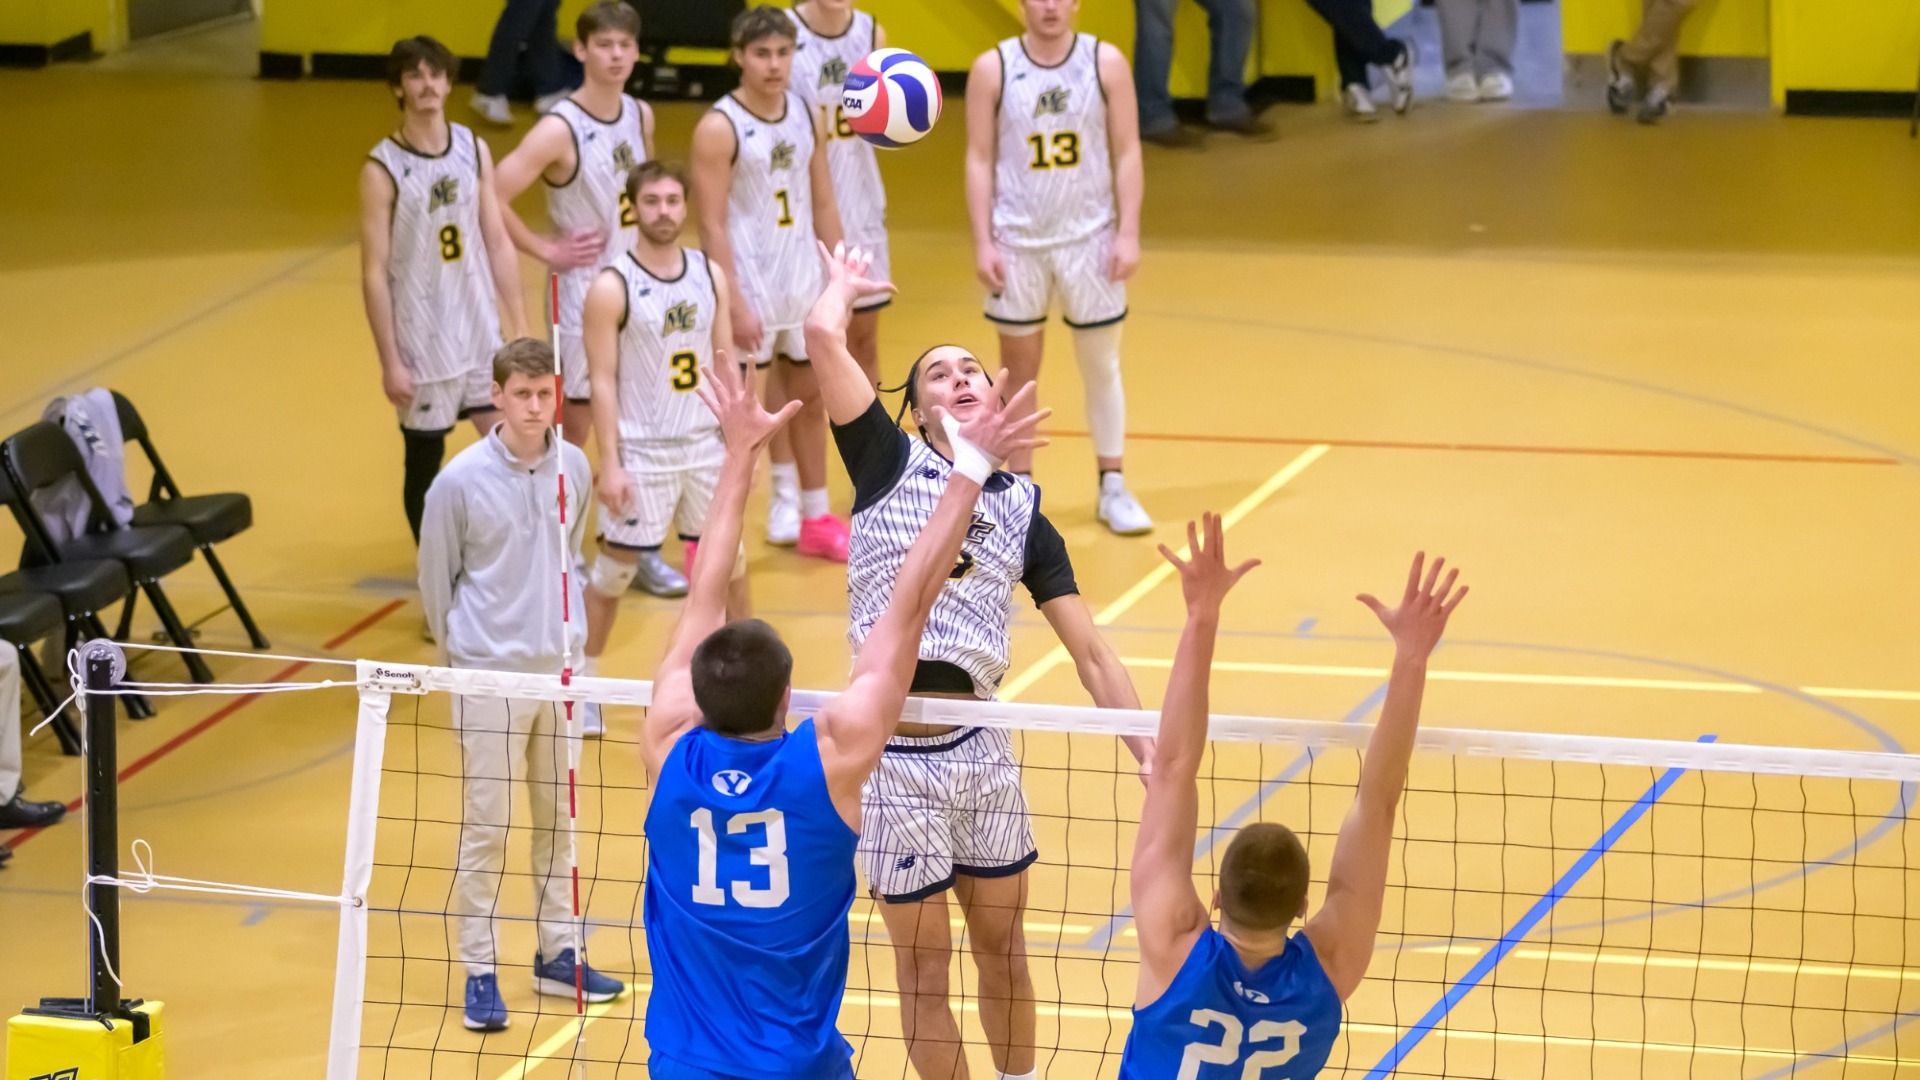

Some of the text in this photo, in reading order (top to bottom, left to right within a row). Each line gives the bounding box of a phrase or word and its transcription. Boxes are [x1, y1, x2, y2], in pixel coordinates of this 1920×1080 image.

[1028, 131, 1080, 169] 13
[775, 190, 794, 227] 1
[439, 224, 462, 262] 8
[669, 350, 699, 392] 3
[384, 670, 414, 678] Senoh
[717, 772, 748, 796] Y
[690, 807, 790, 908] 13
[1180, 1008, 1307, 1080] 22
